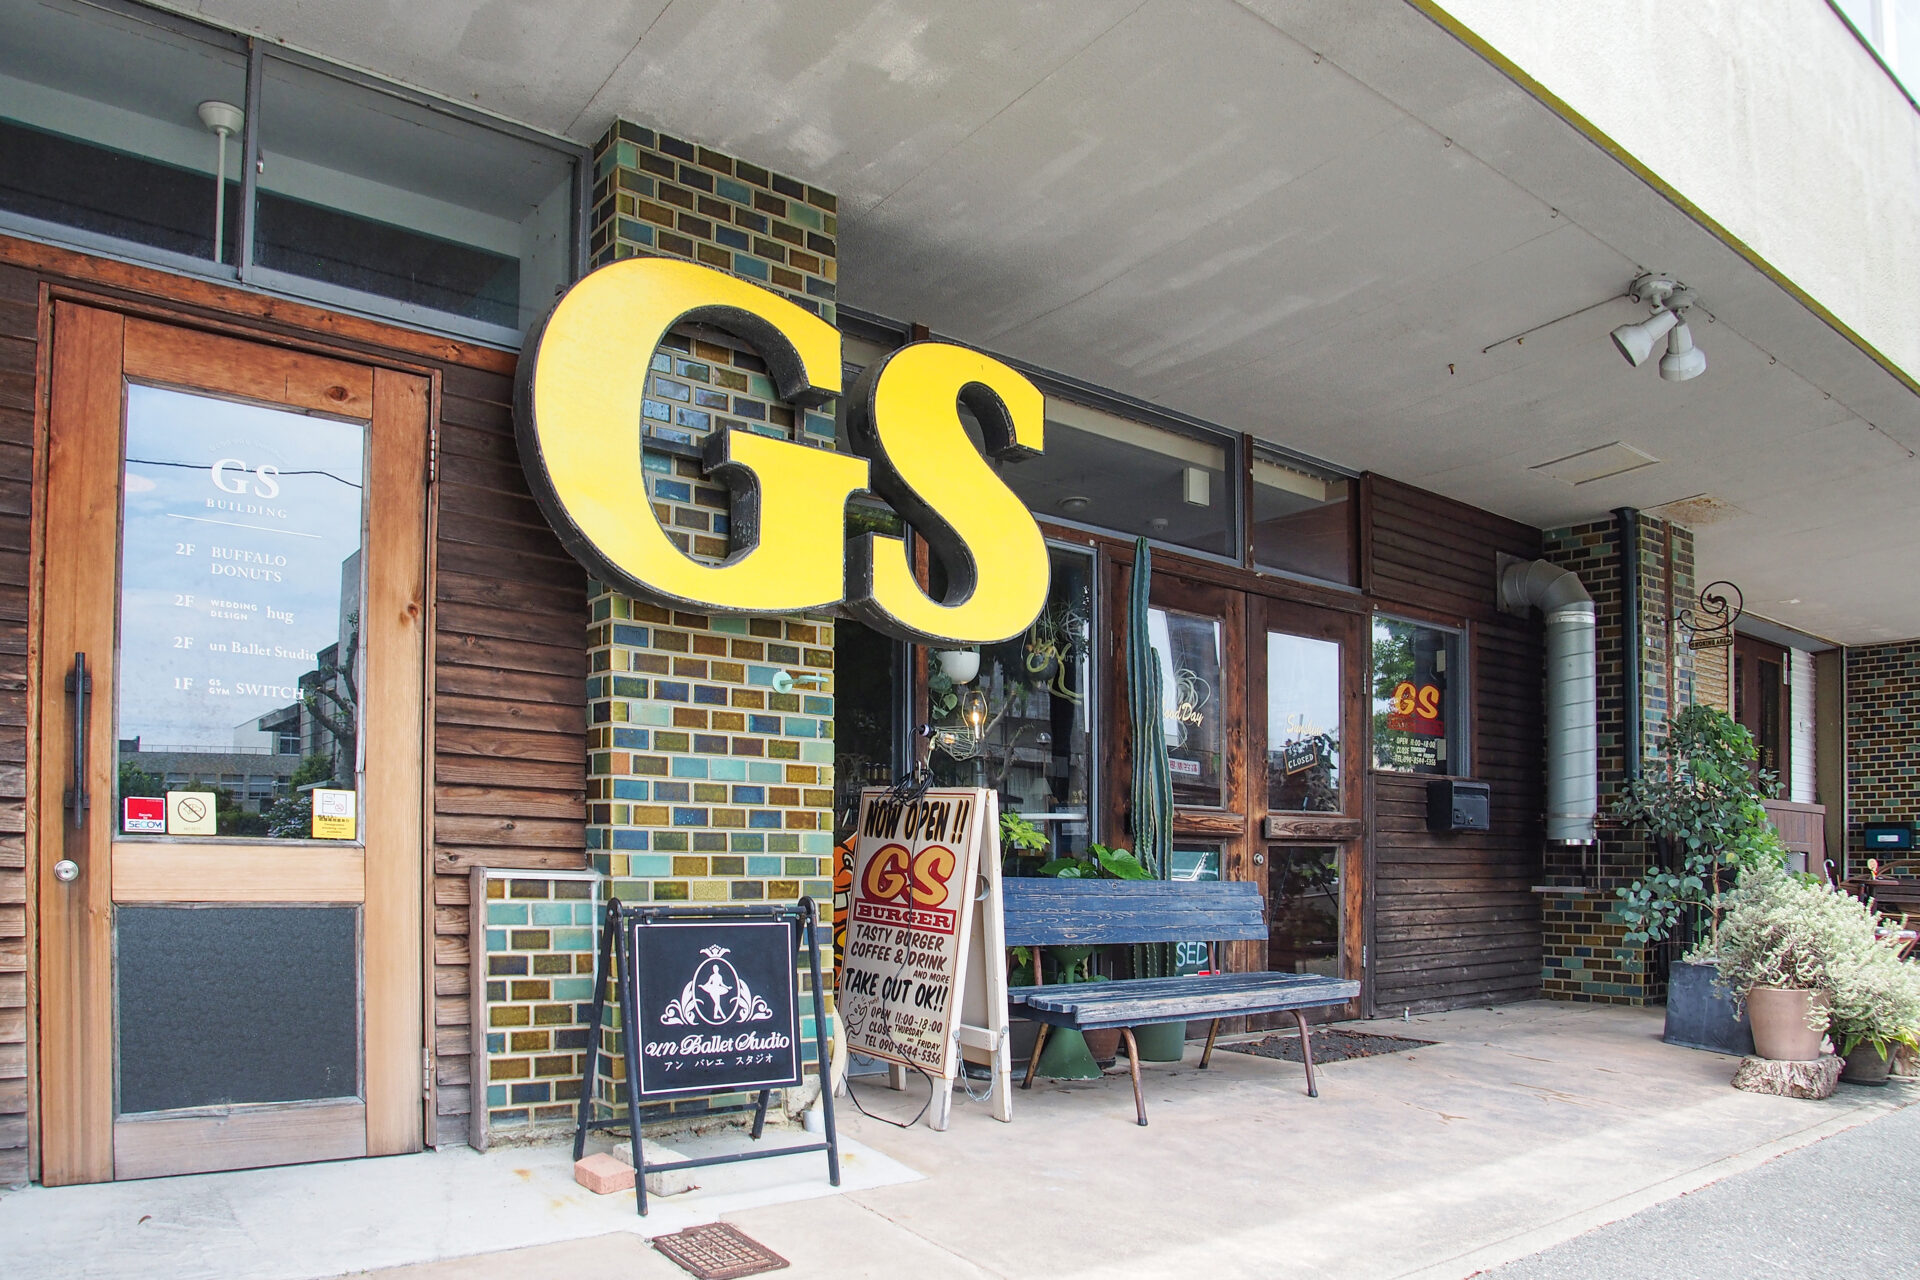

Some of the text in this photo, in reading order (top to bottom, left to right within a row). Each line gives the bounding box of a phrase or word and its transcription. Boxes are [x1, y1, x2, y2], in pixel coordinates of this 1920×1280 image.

[520, 256, 1051, 645] GS
[211, 458, 280, 499] GS
[206, 498, 288, 519] BUILDING
[175, 543, 287, 567] 2F BUFFALO
[211, 563, 282, 583] DONUTS
[174, 595, 258, 612] 2F WEDDING
[210, 610, 248, 621] DESIGN
[266, 606, 295, 625] hug
[173, 636, 318, 662] 2F un Ballet Studio
[174, 677, 222, 690] 1F GS
[208, 686, 230, 696] GYM
[236, 682, 305, 700] SWITCH
[1392, 680, 1441, 719] GS
[1163, 702, 1204, 727] ood Day
[1287, 753, 1314, 769] CLOSED
[128, 820, 163, 829] SECOM
[864, 799, 903, 839] NOW
[904, 801, 951, 842] OPEN
[861, 843, 956, 908] GS
[858, 904, 951, 928] BURGER
[856, 924, 945, 952] TASTY BURGER
[850, 941, 948, 972] COFFEE & DRINK
[913, 970, 950, 984] AND MORE
[845, 968, 949, 1013] TAKE OUT OK!!
[870, 1006, 892, 1021] OPEN
[868, 1021, 925, 1038] CLOSE THURSDAY
[645, 1031, 790, 1057] un Ballet Studio
[865, 1034, 877, 1047] TEL
[917, 1039, 941, 1052] FRIDAY
[664, 1053, 773, 1071] アン バレエ スタジオ
